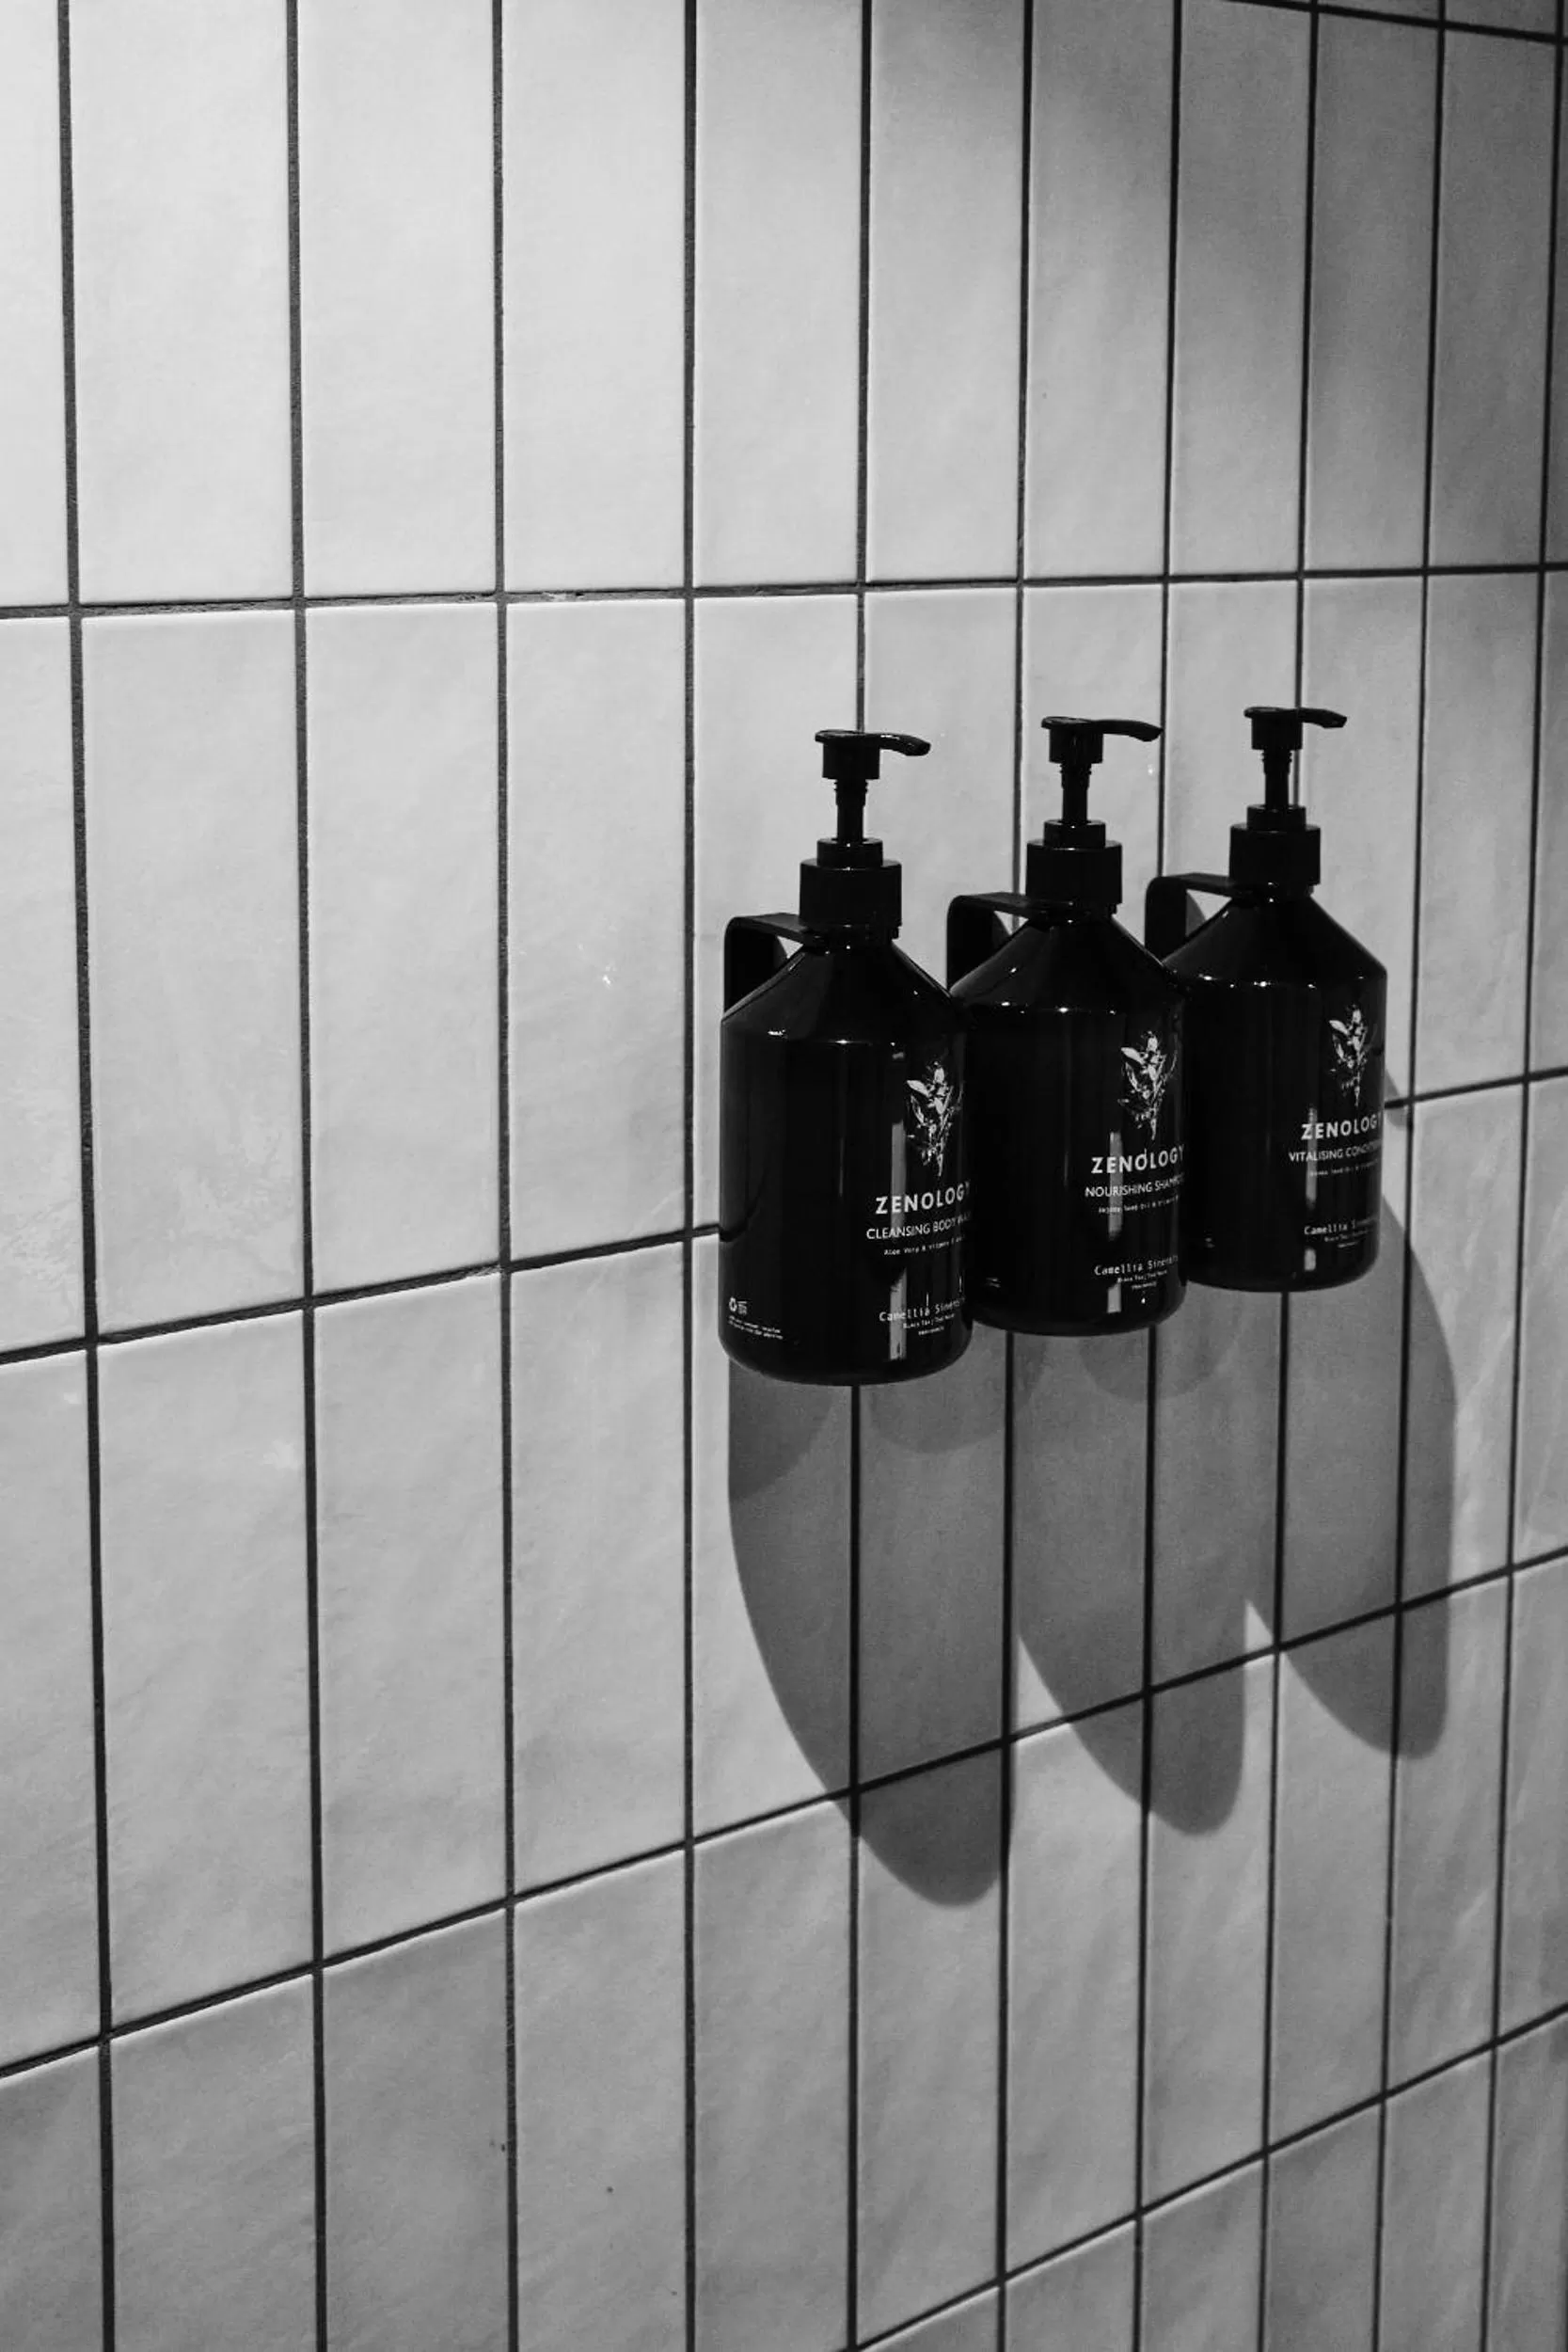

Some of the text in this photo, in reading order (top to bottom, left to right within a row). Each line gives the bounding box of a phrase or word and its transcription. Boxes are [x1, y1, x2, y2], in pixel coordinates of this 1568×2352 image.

[1091, 1144, 1184, 1173] ZENOLOGY
[1289, 1149, 1343, 1162] VITALISING
[1085, 1182, 1152, 1198] NOURISHING
[866, 1223, 930, 1240] CLEANSING
[1094, 1263, 1143, 1276] Camellia
